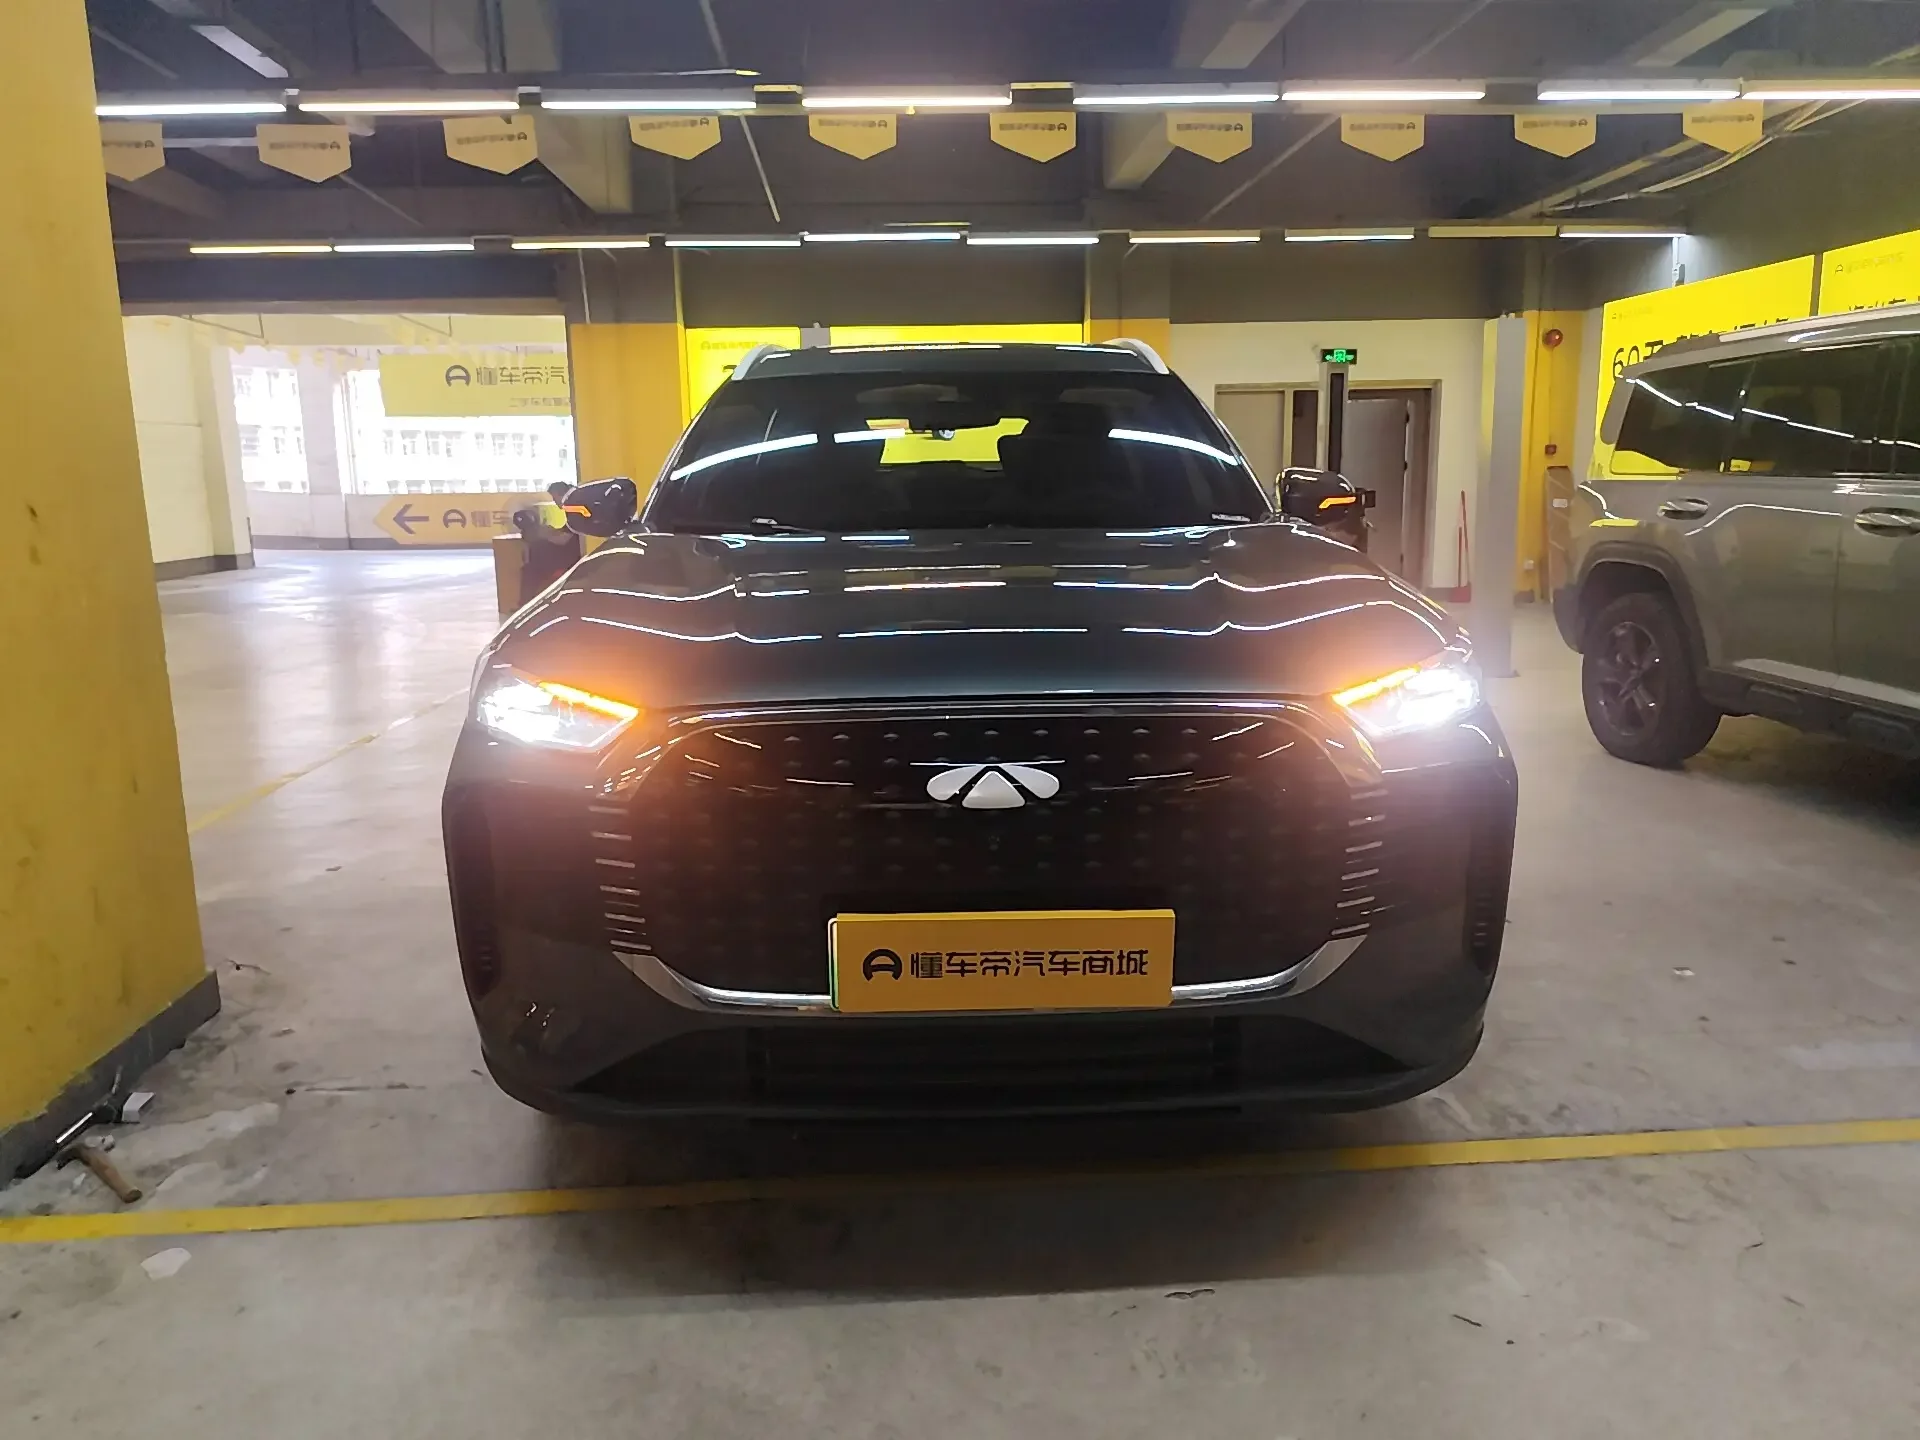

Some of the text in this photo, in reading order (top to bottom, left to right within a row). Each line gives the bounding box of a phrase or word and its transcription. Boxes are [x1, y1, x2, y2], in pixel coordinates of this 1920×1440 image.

[911, 950, 1148, 978] 懂车帝汽车商城
